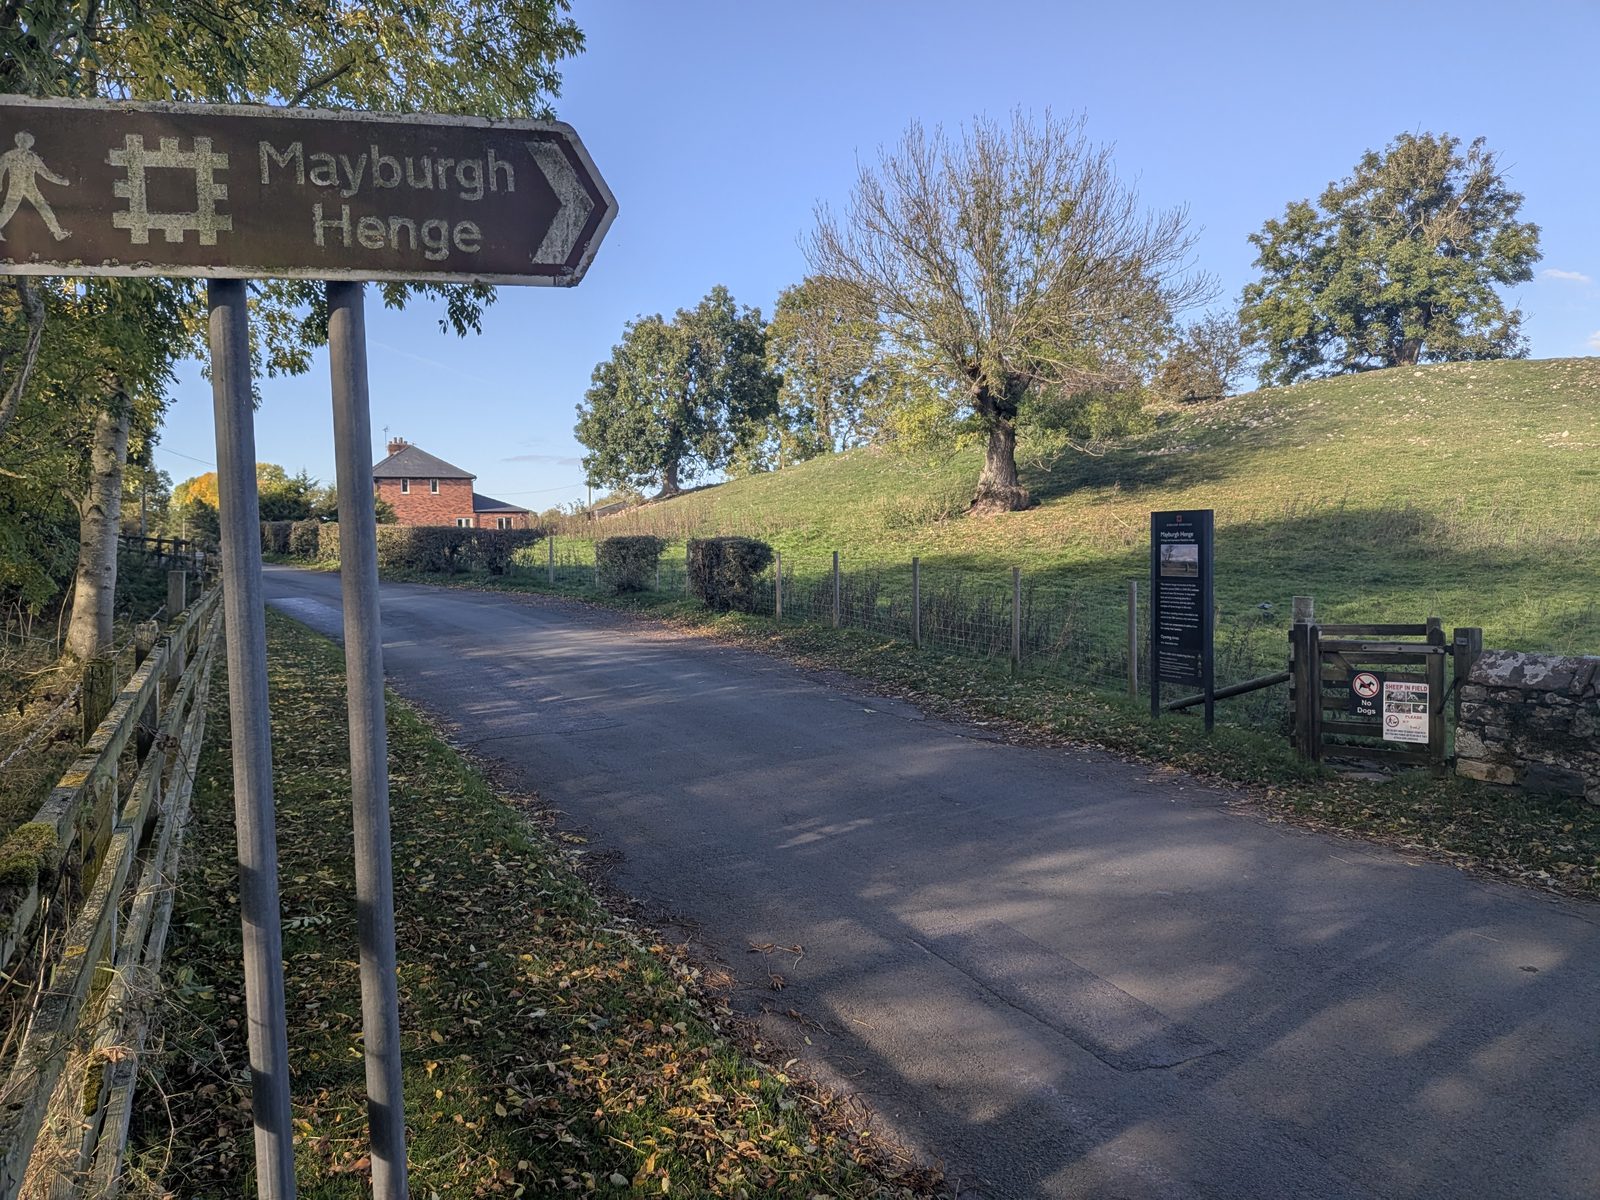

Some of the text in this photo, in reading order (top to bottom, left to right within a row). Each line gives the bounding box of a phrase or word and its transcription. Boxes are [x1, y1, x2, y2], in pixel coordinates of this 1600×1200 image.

[259, 141, 515, 200] Mayburgh
[313, 203, 481, 261] Henge
[1357, 707, 1376, 715] Dogs
